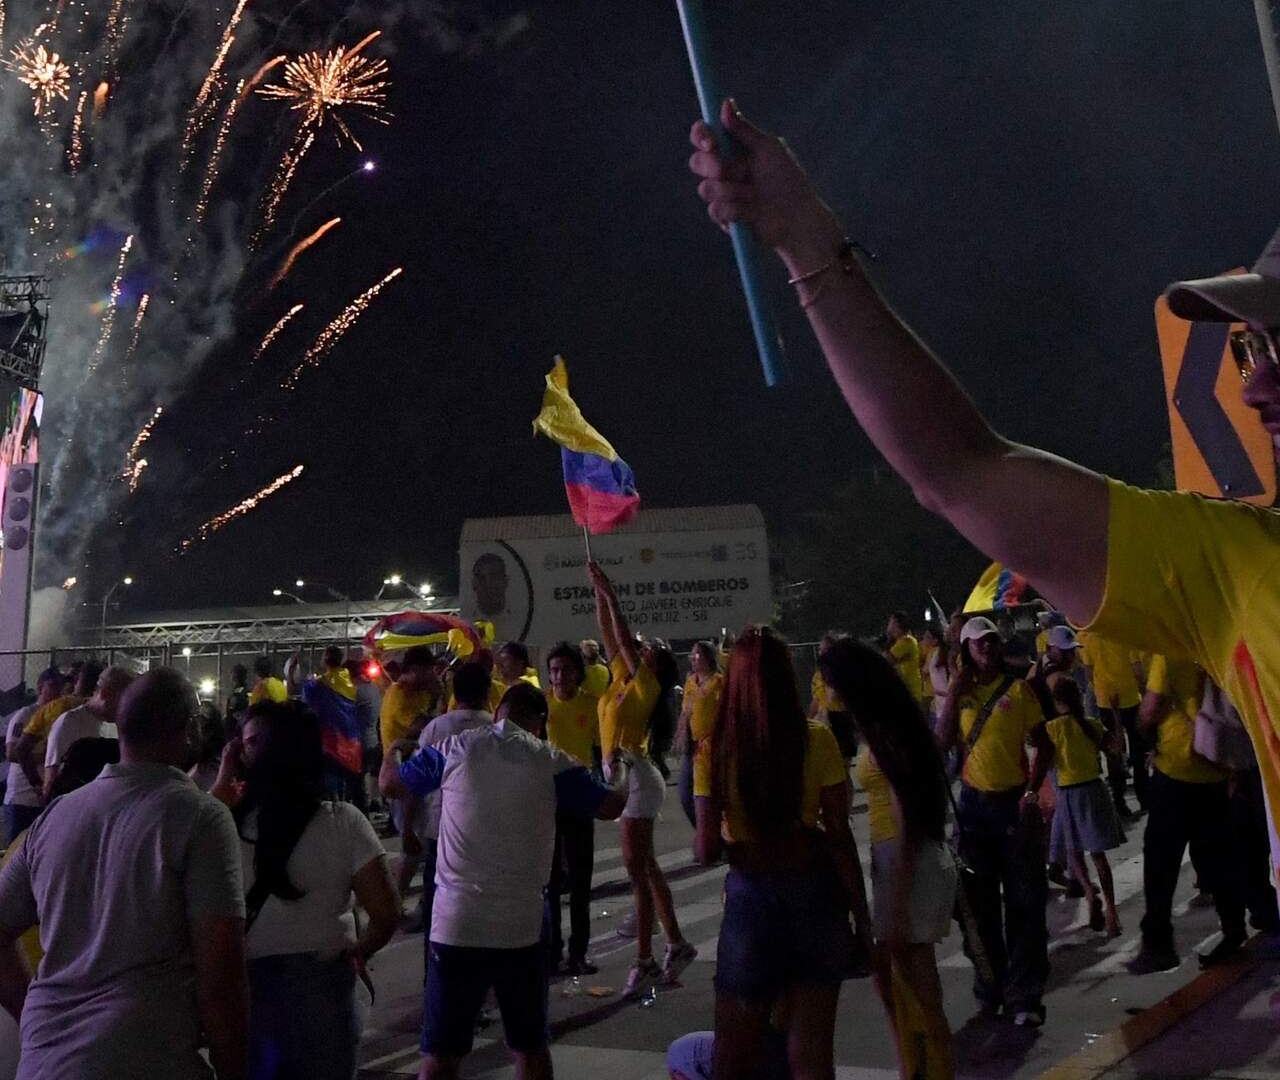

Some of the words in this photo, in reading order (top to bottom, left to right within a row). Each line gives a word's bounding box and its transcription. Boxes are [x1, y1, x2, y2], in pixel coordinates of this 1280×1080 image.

[553, 579, 630, 601] ESTAÓN
[634, 581, 656, 596] DE
[659, 577, 749, 594] BOMBEROS
[640, 598, 677, 612] JAVIER
[681, 595, 733, 609] ENRIQUE
[651, 610, 680, 623] RUIZ
